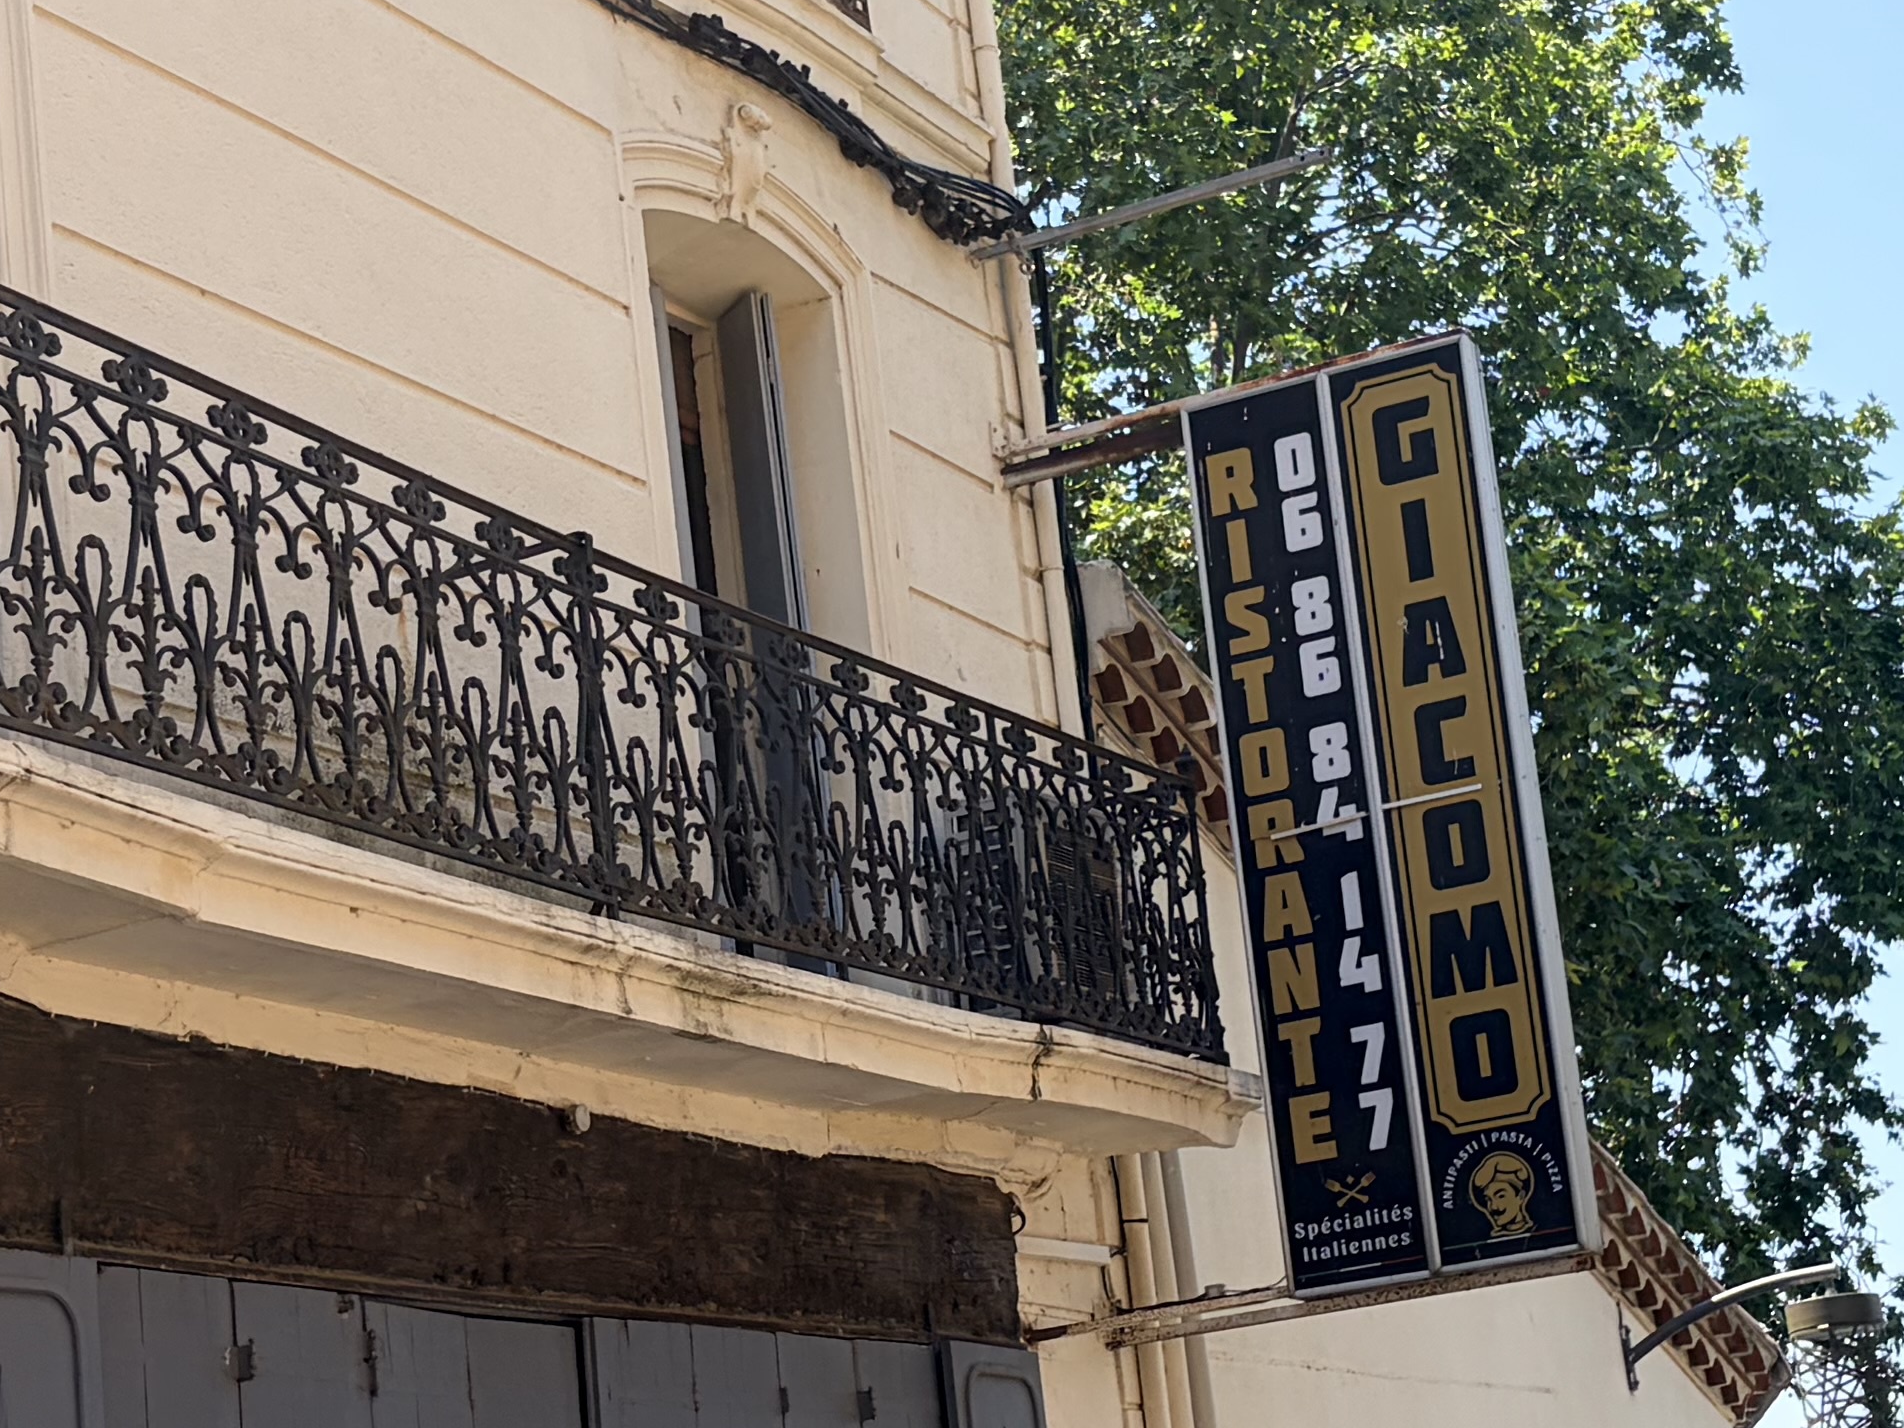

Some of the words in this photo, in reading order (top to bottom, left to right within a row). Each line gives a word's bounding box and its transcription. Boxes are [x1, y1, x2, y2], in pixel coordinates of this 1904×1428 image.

[1274, 432, 1324, 553] 06
[1291, 575, 1342, 698] 86
[1205, 447, 1338, 1165] RISTORANTE
[1309, 722, 1364, 842] 84
[1372, 395, 1520, 1103] GIACOMO
[1339, 871, 1383, 993] 14
[1350, 1022, 1393, 1152] 77
[1294, 1204, 1414, 1241] Spécialités
[1442, 1140, 1479, 1209] ANTIPASTI
[1491, 1131, 1534, 1149] PASTA
[1541, 1151, 1563, 1193] PIZZA
[1303, 1232, 1412, 1263] Italiennes
